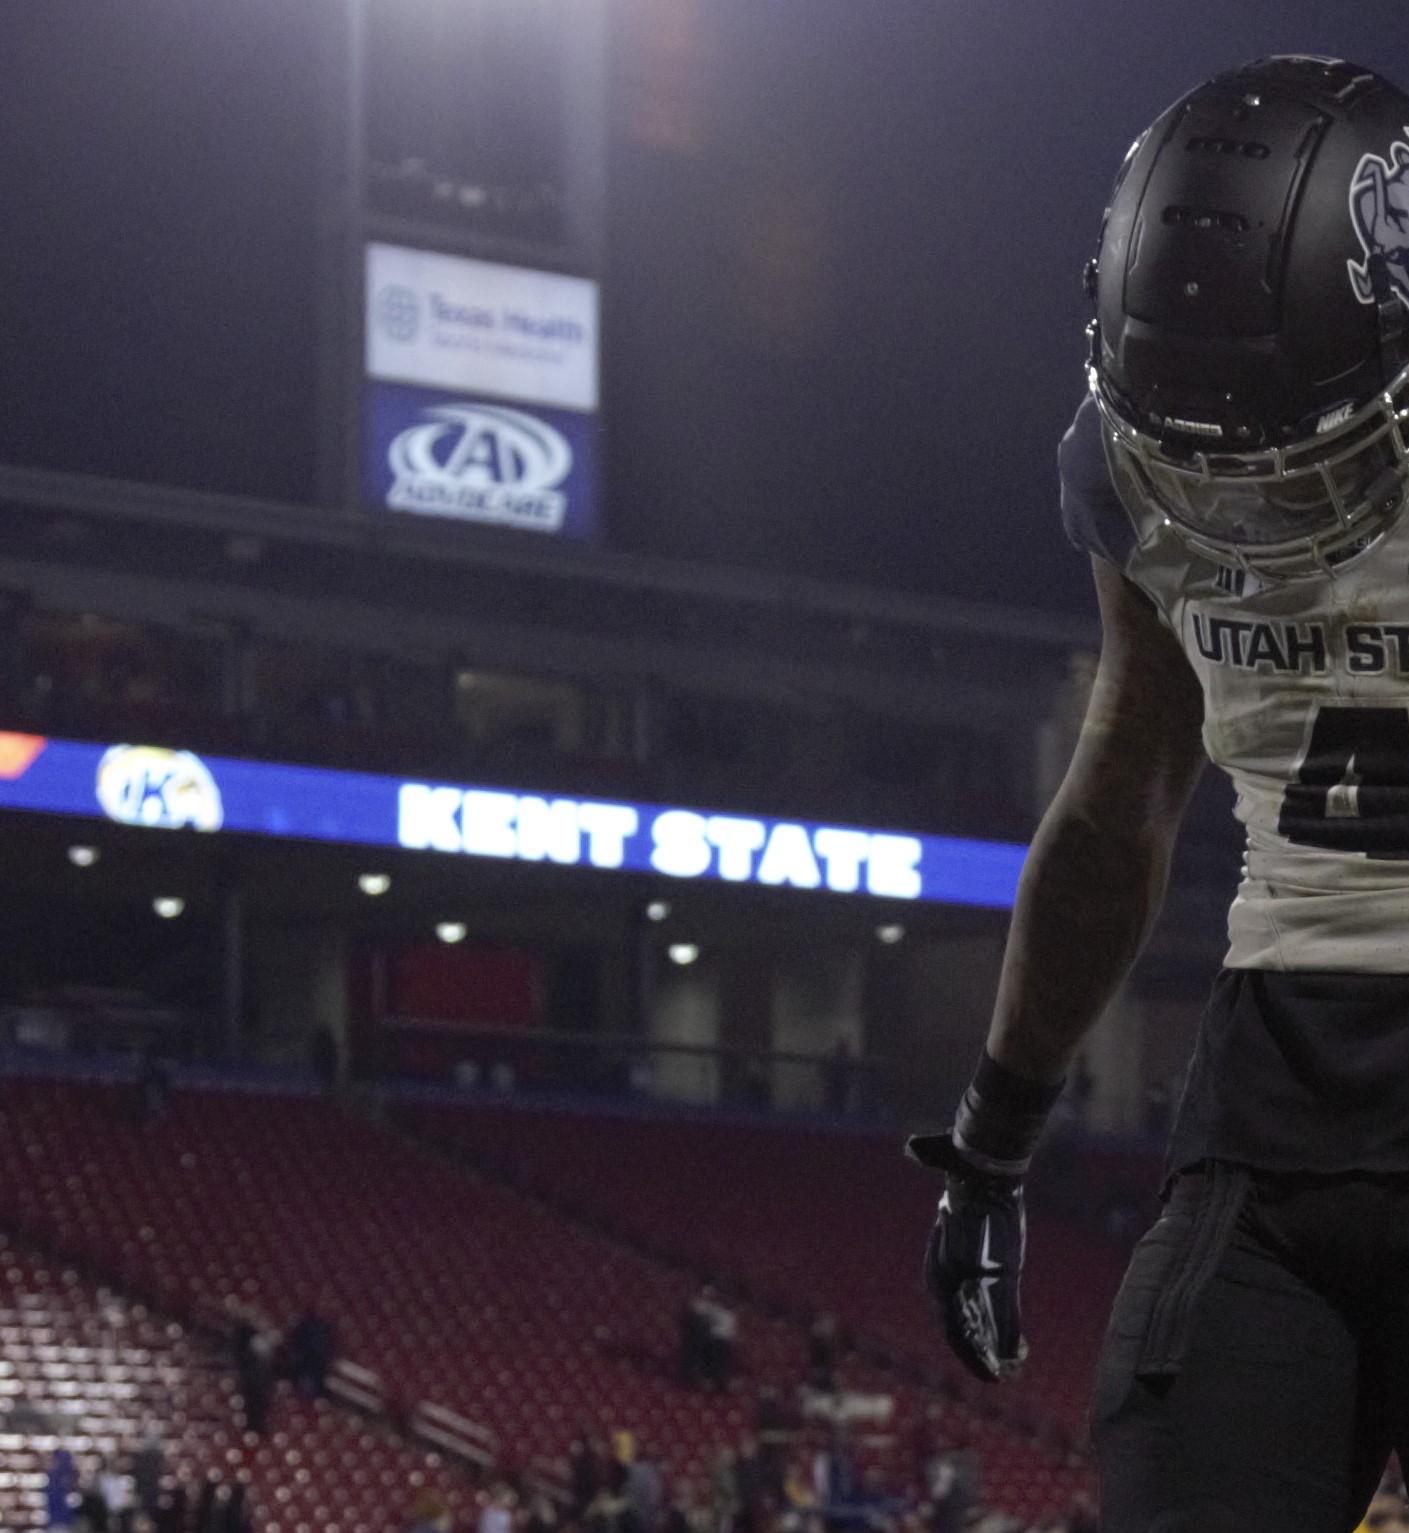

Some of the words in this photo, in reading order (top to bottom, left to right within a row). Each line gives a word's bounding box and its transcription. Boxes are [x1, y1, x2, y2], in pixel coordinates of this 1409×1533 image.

[1315, 402, 1355, 435] NIKE
[1191, 612, 1329, 676] UTAH
[398, 783, 638, 868] KENT
[650, 810, 923, 899] STATE
